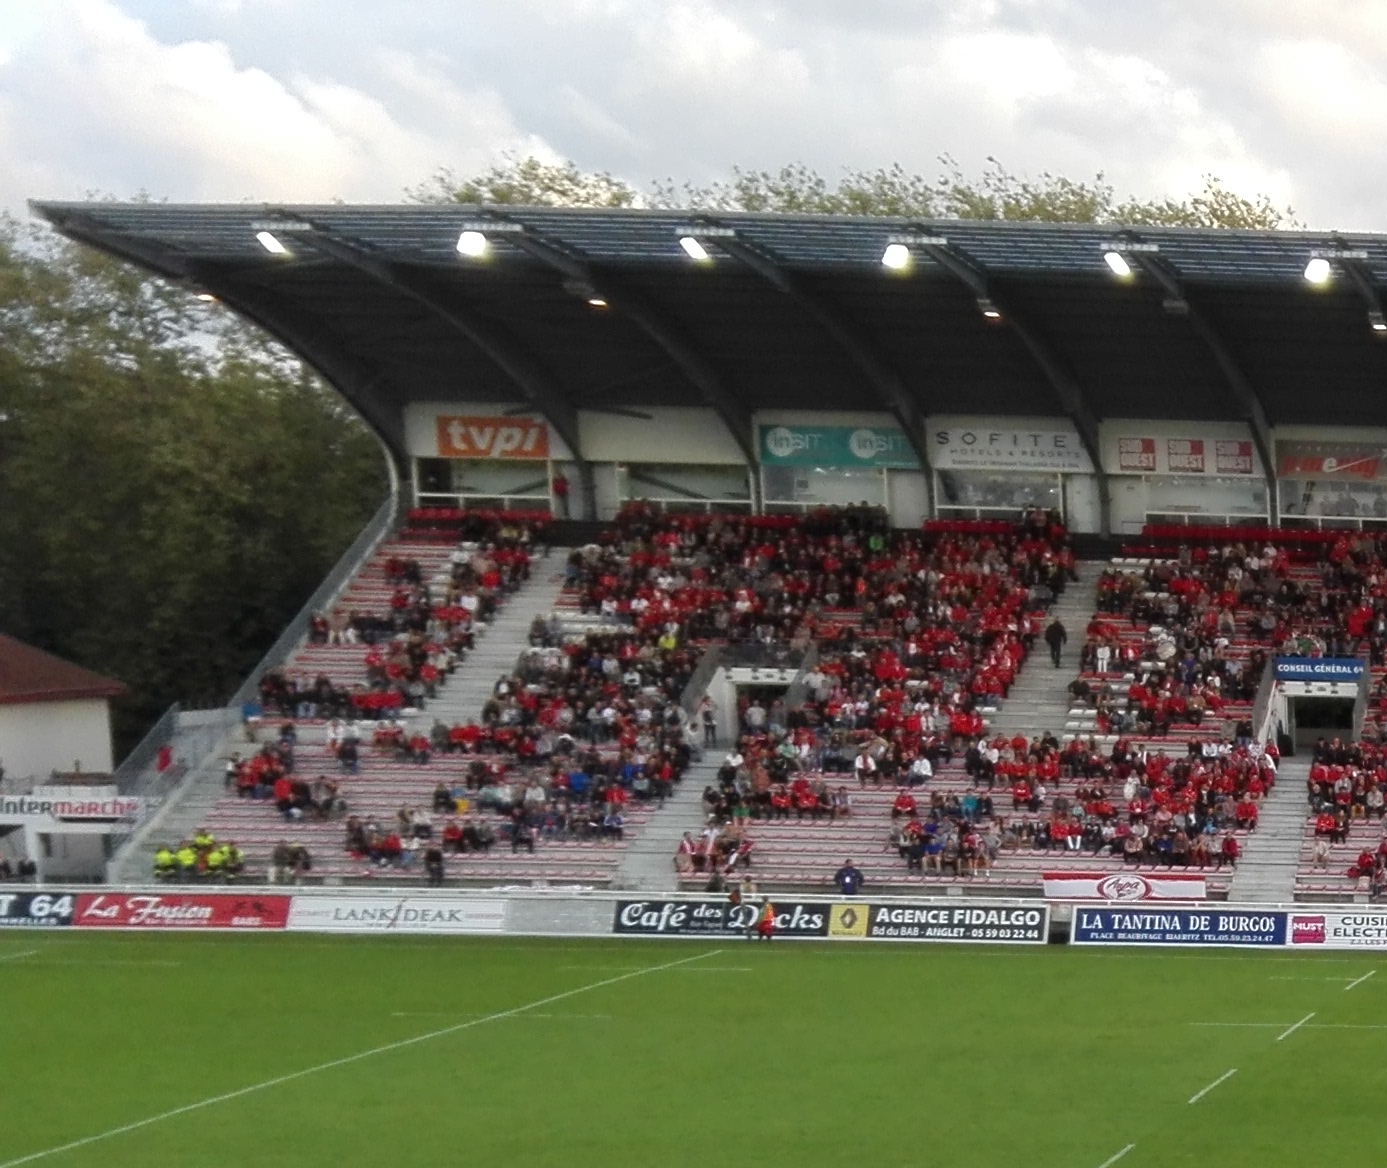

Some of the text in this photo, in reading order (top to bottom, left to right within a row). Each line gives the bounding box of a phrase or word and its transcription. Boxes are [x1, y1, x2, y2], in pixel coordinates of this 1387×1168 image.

[1278, 664, 1313, 673] CONSEIL
[30, 895, 73, 916] 64
[83, 895, 213, 925] La Fusion
[620, 902, 823, 931] Café des Dcks
[876, 907, 1040, 926] AGENCE FIDALGO
[1081, 914, 1275, 932] LA TANTINA DE BURGOS
[872, 927, 885, 936] Bd
[887, 928, 899, 936] du
[901, 928, 919, 936] BAB
[926, 928, 965, 938] ANGLET
[972, 929, 984, 938] 05
[985, 929, 998, 938] 59
[1000, 930, 1012, 939] 03
[1013, 930, 1025, 939] 22
[1026, 930, 1039, 939] 44
[1090, 932, 1115, 940] PLACE
[1293, 922, 1324, 932] MUST
